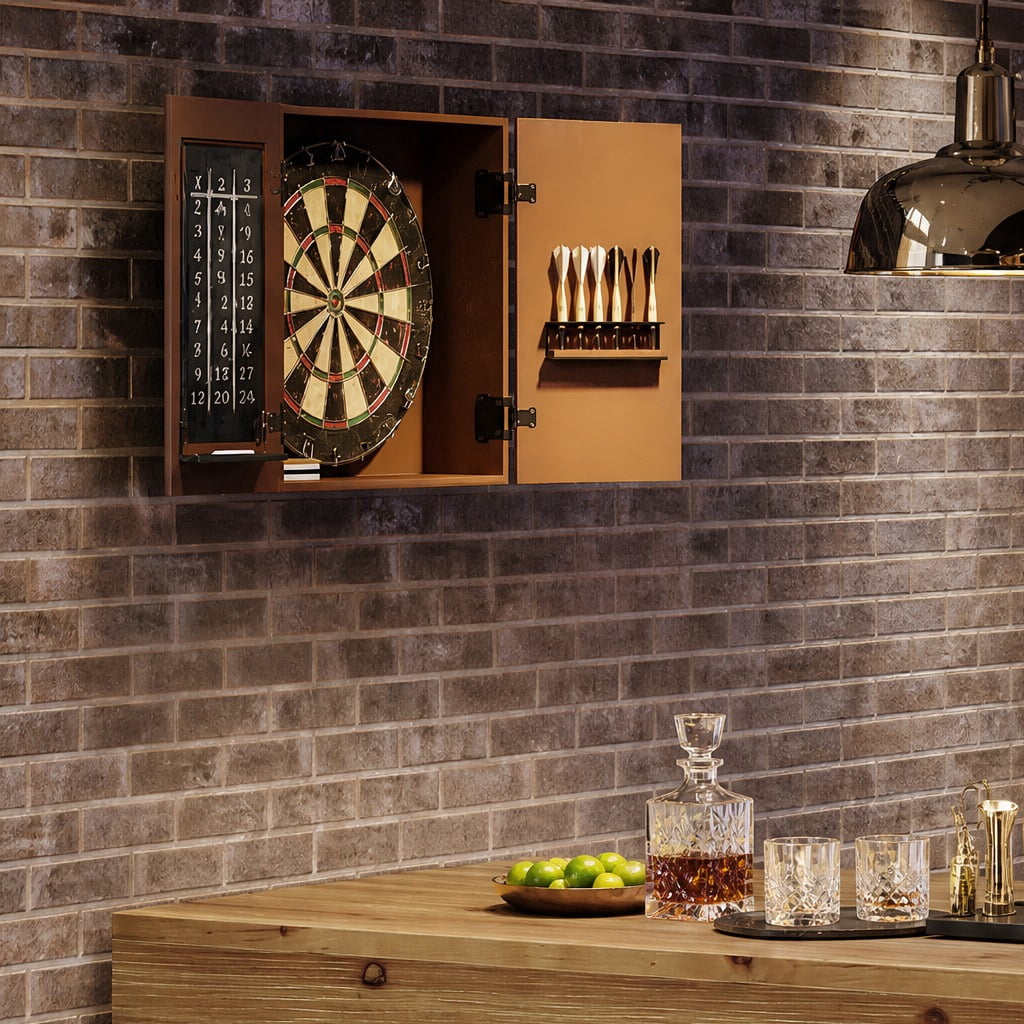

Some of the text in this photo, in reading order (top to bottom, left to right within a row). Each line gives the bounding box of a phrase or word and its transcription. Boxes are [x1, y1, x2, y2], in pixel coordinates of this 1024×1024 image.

[217, 177, 225, 191] 2
[243, 178, 251, 192] 3
[193, 199, 201, 215] 2
[193, 224, 202, 238] 3
[193, 248, 254, 264] 4 9 16
[194, 271, 202, 286] 5
[239, 272, 254, 287] 15
[221, 295, 228, 310] 2
[194, 318, 254, 334] 7 4 14
[220, 342, 228, 357] 6
[194, 367, 202, 381] 9
[239, 366, 254, 380] 27
[191, 390, 205, 405] 12
[214, 390, 230, 405] 20
